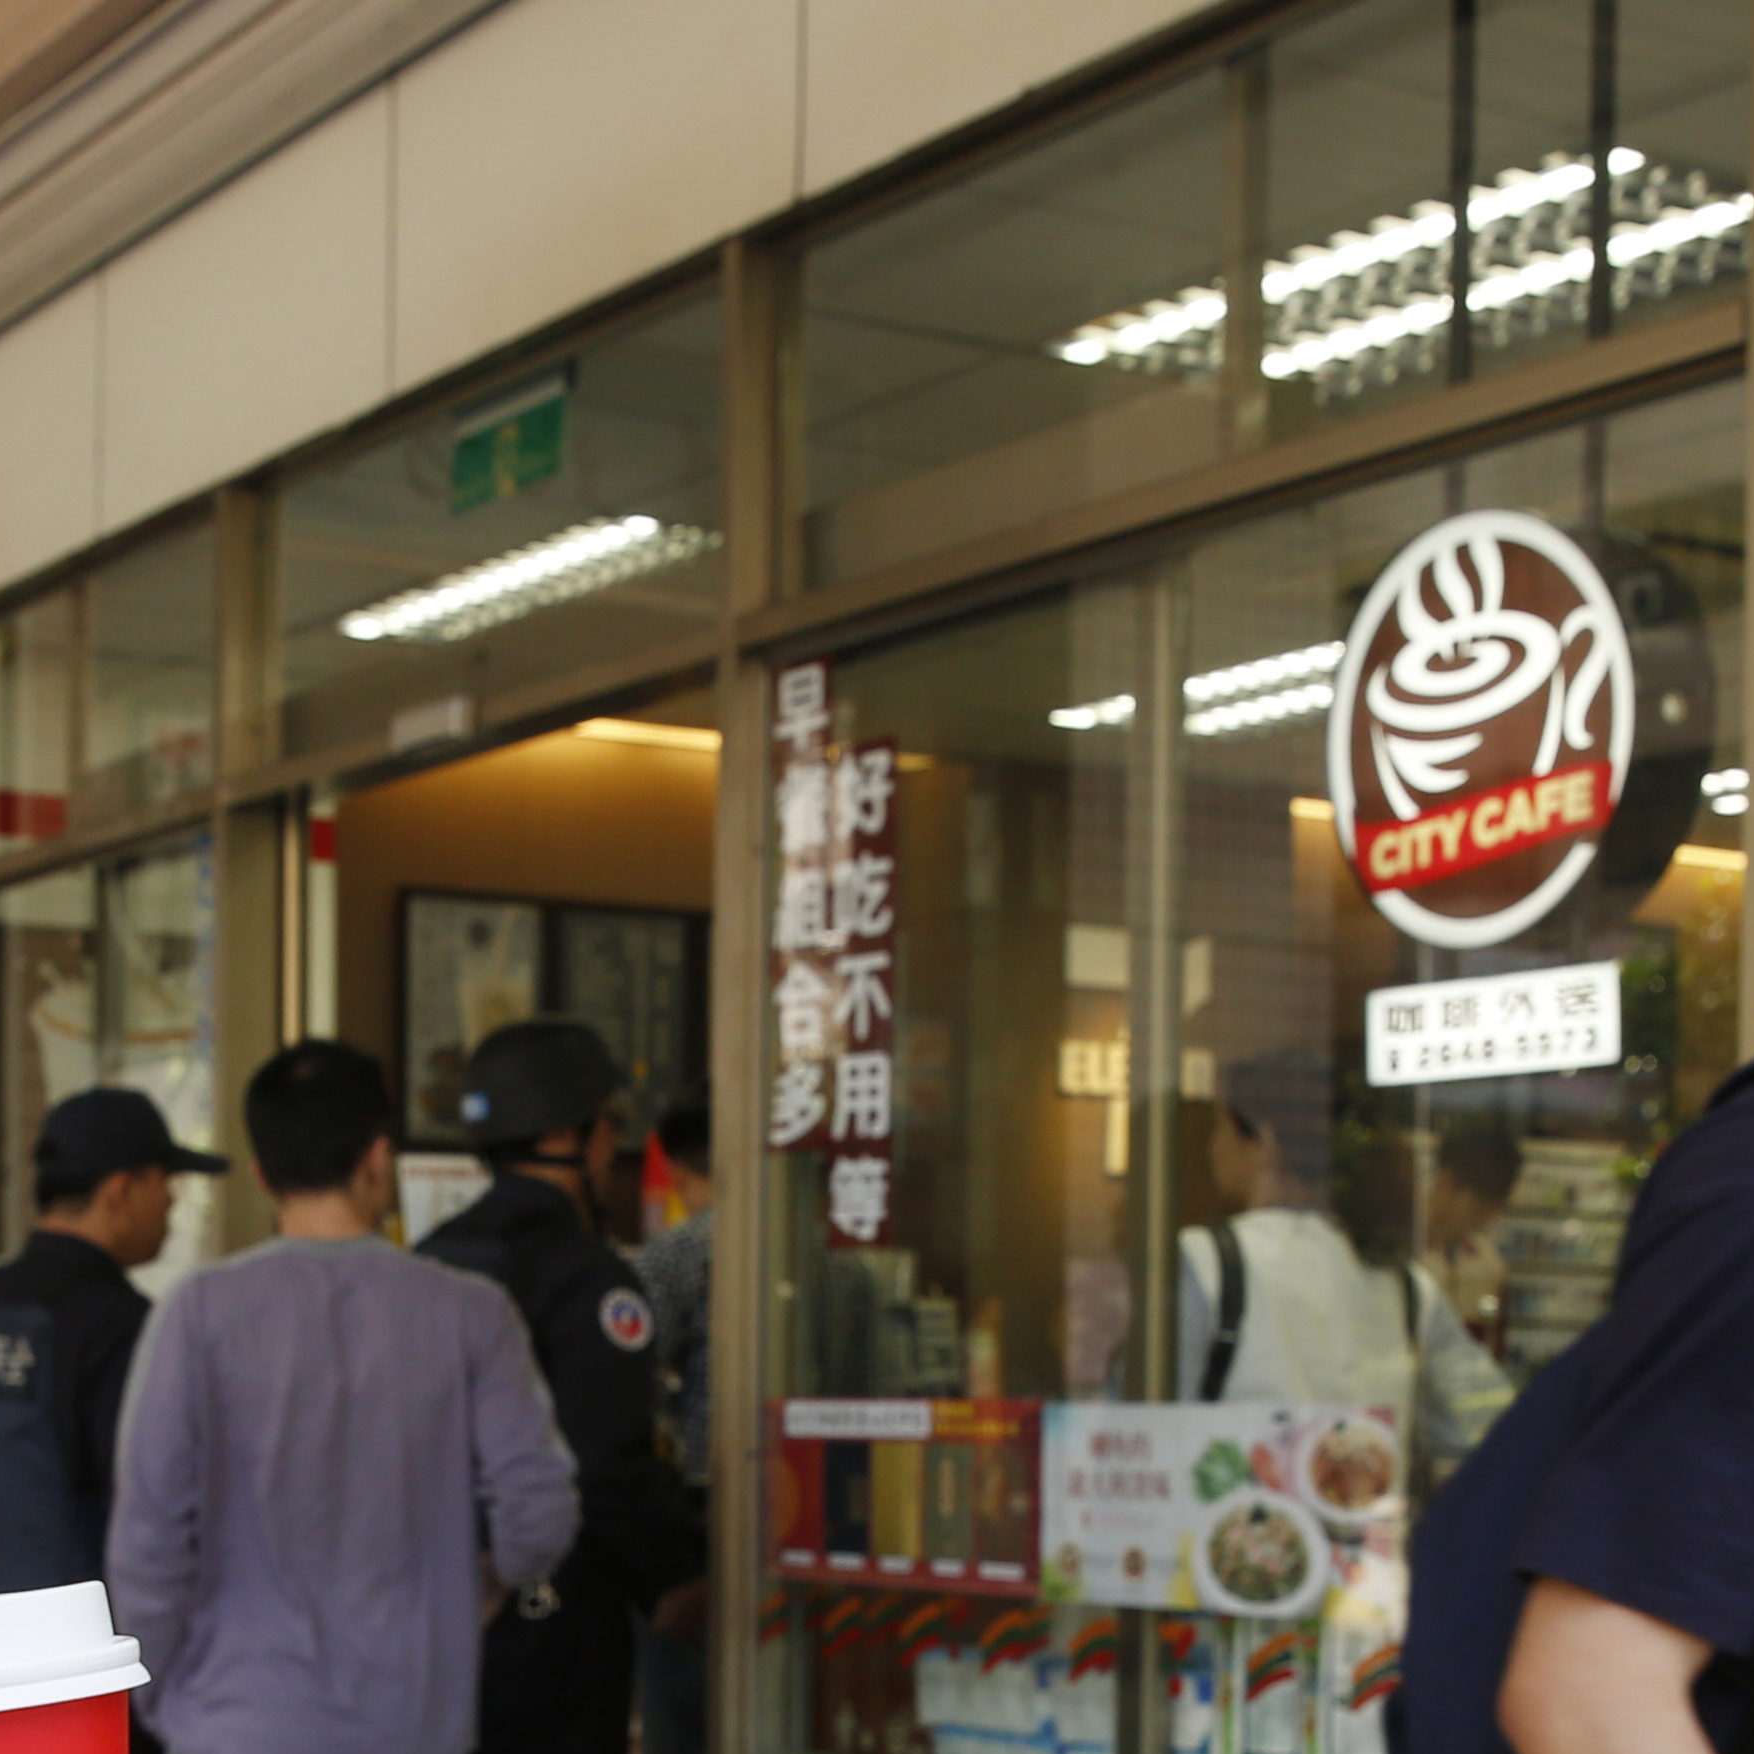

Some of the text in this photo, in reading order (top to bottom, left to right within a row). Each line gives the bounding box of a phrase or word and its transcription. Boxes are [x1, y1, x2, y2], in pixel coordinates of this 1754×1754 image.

[1369, 769, 1595, 880] CITY CAFE
[829, 746, 896, 1242] 好吃不用等
[1387, 983, 1598, 1032] 咖啡外送
